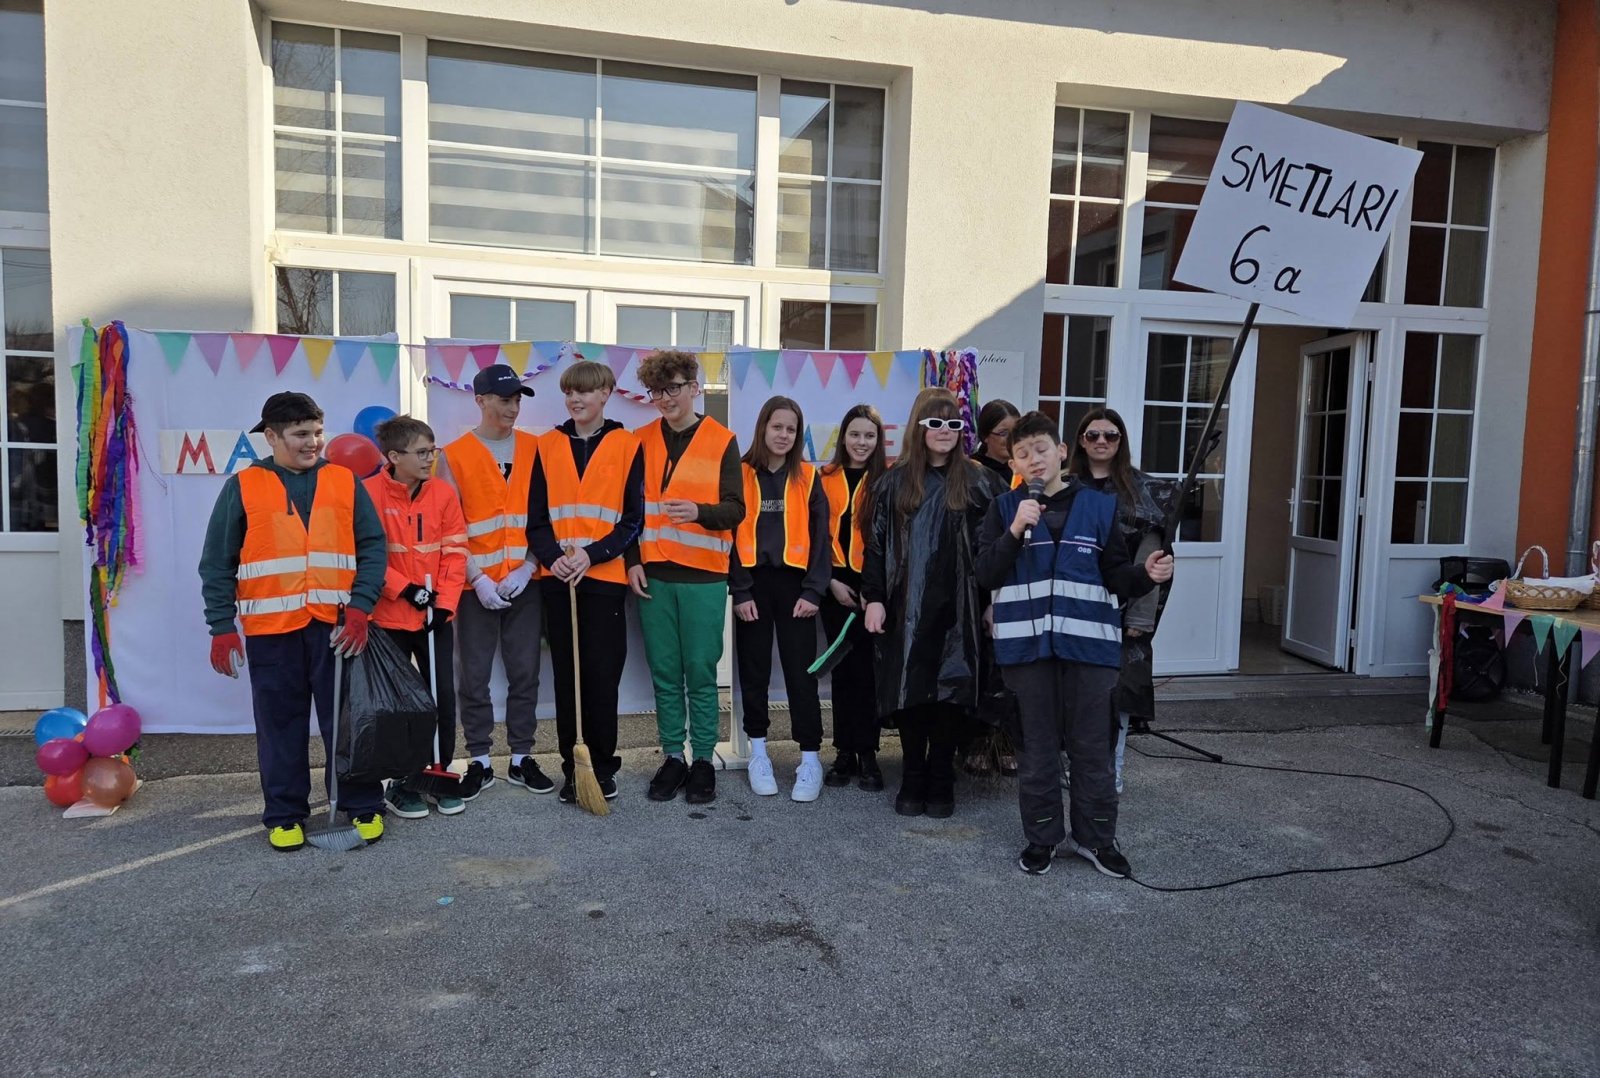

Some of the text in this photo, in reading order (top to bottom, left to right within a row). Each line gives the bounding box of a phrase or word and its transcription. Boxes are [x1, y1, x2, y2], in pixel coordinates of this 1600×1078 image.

[1221, 145, 1399, 232] SMETLARI
[1229, 224, 1302, 294] 6 a
